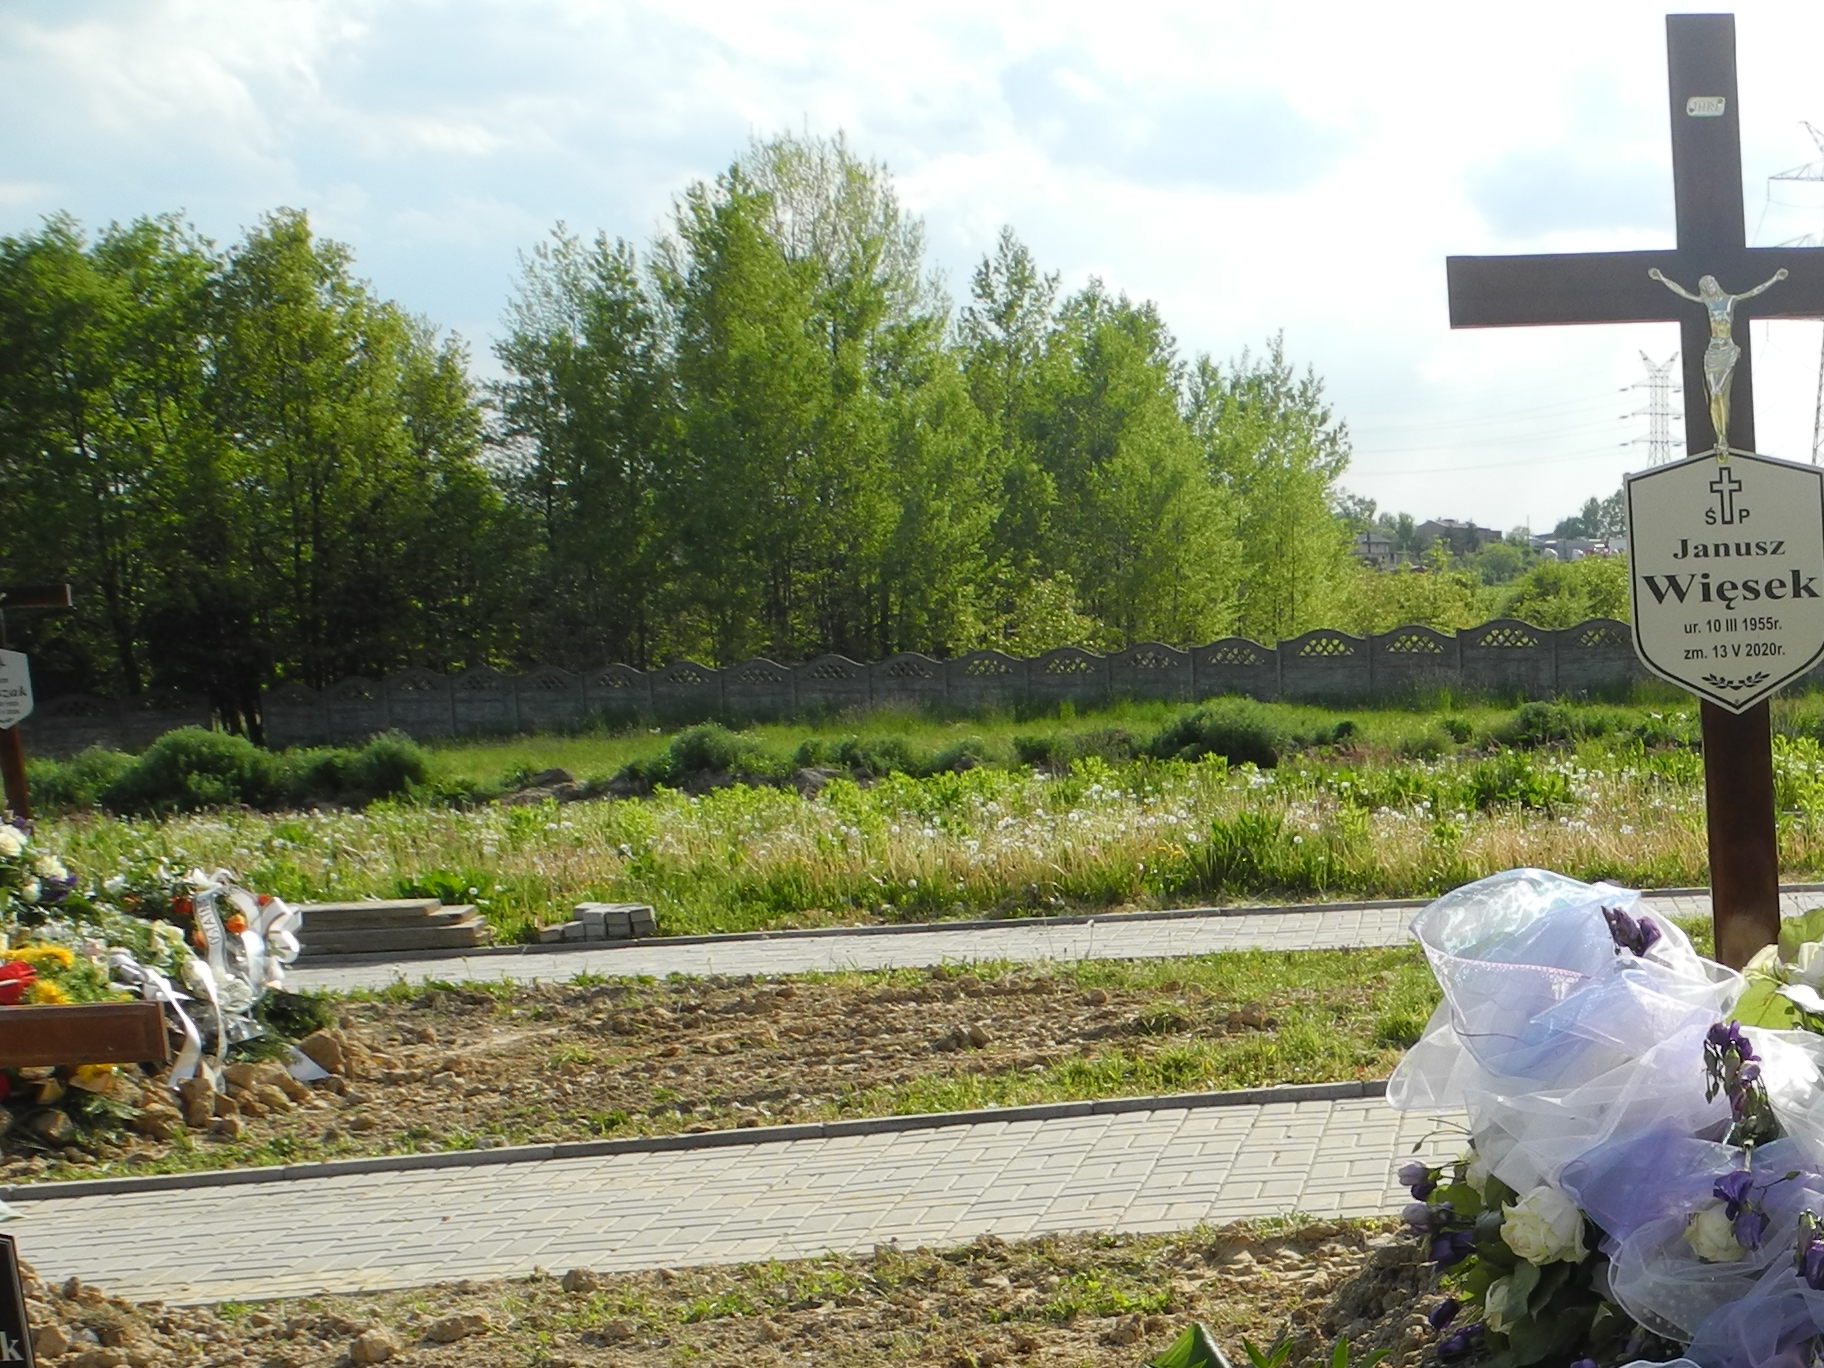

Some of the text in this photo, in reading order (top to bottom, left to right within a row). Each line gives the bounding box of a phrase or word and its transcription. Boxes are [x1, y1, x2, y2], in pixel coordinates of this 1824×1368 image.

[1739, 509, 1750, 524] P
[1673, 538, 1786, 560] Janusz
[1642, 569, 1821, 611] Więsek
[1684, 617, 1782, 634] ur. 10 III 1955r.
[1684, 642, 1786, 660] zm. 13 V 2020r.
